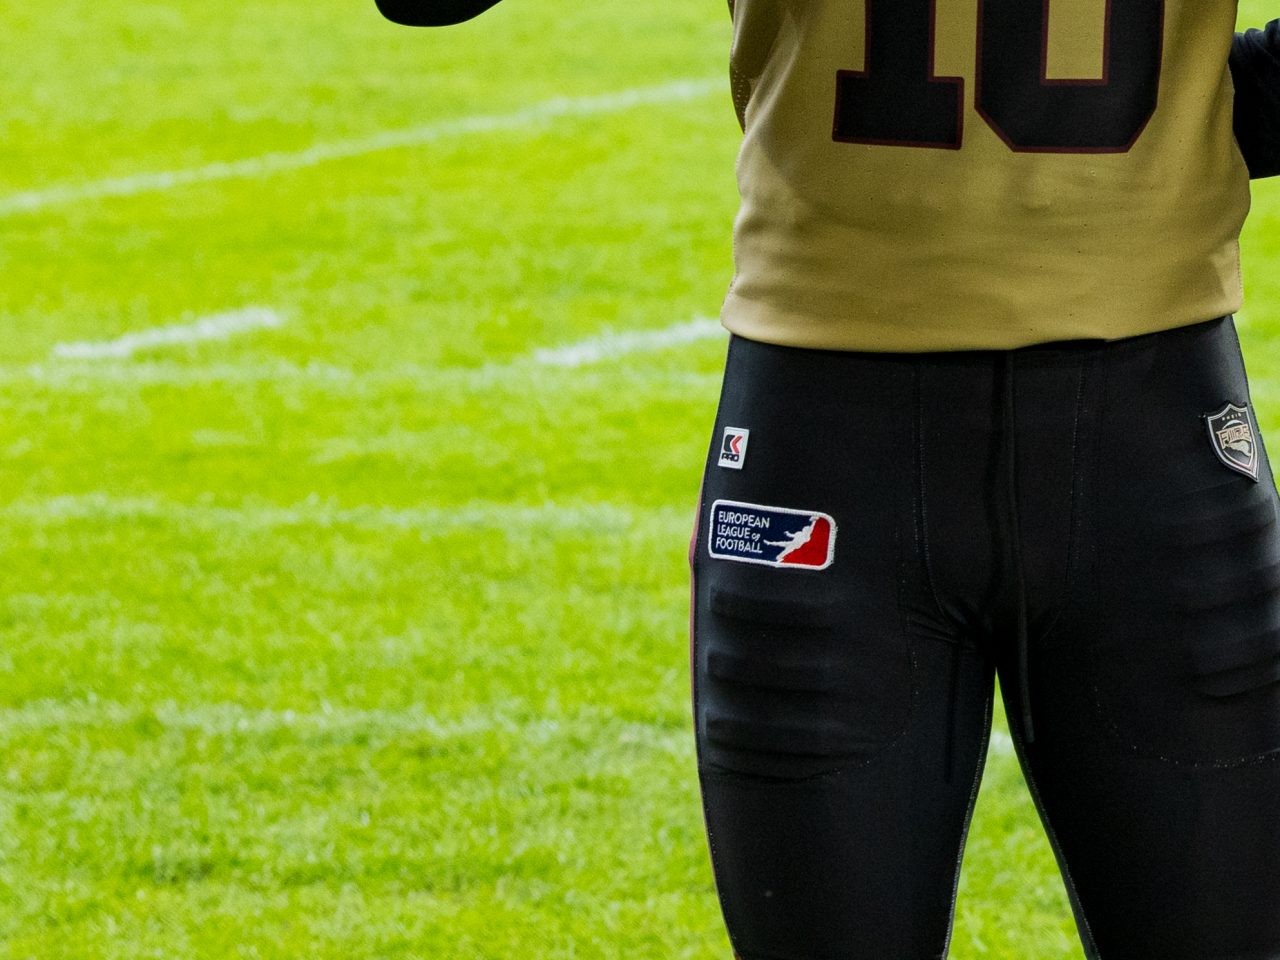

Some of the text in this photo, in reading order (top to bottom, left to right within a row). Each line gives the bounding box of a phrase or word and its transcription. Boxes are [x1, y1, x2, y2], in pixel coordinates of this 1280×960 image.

[1216, 424, 1252, 449] FIRE
[721, 452, 740, 463] PRO
[718, 510, 771, 529] EUROPEAN
[717, 524, 751, 539] LEAGUE
[716, 538, 763, 554] FOOTBALL
